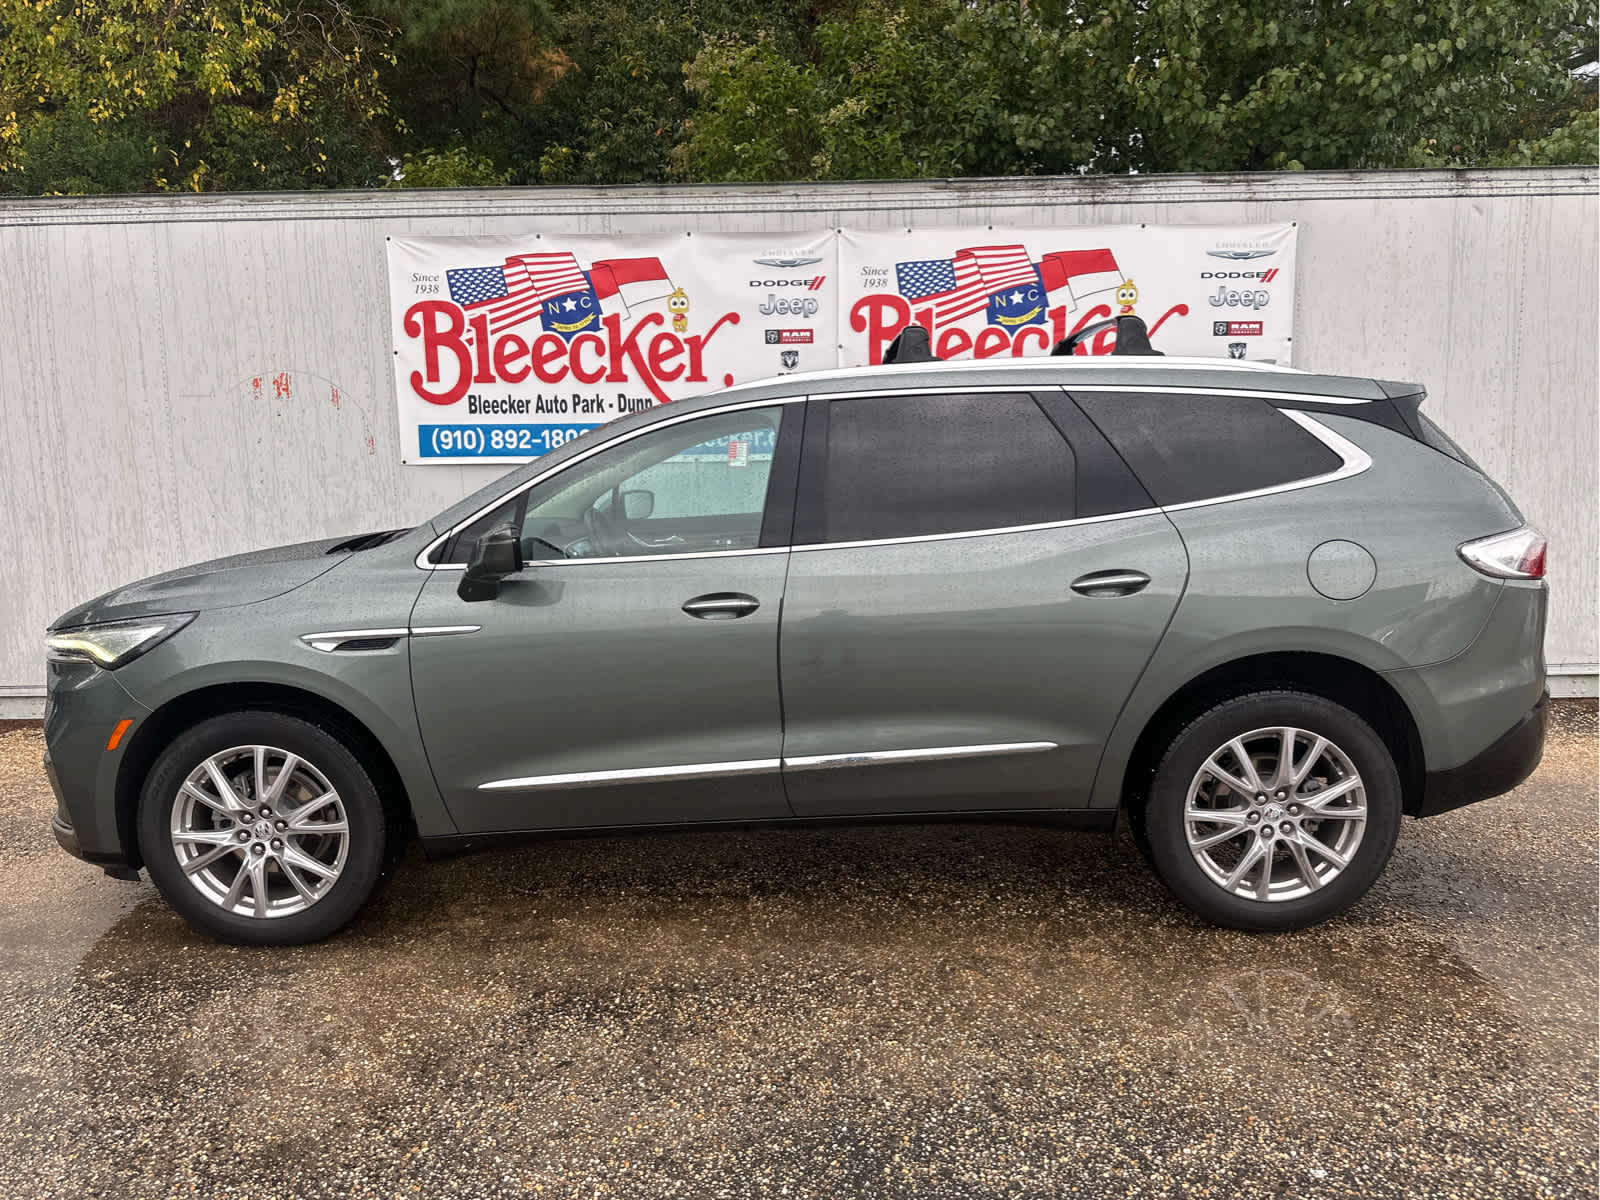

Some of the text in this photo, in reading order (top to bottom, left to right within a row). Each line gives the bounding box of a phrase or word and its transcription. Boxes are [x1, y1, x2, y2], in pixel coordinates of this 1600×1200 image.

[861, 265, 889, 275] Since
[1200, 271, 1267, 279] DODGE
[411, 272, 440, 282] Since
[749, 279, 814, 287] DODGE
[415, 284, 440, 294] 1938
[1208, 285, 1269, 310] Jeep
[760, 293, 819, 318] Jeep
[468, 394, 531, 415] Bleecker
[535, 394, 568, 414] Auto
[572, 393, 605, 414] Park
[617, 393, 653, 413] Dunn
[432, 428, 591, 454] (910) 892-180
